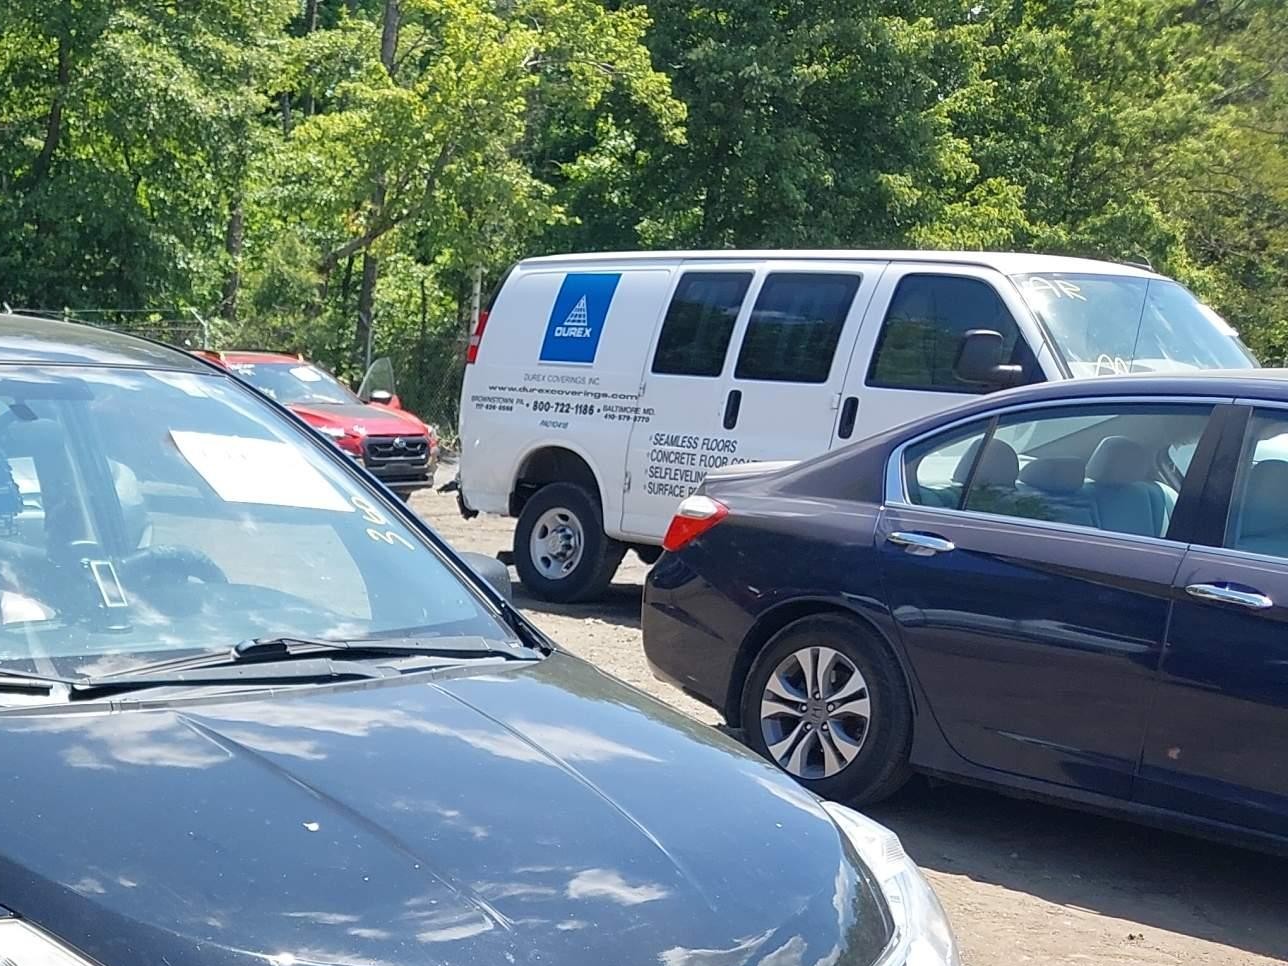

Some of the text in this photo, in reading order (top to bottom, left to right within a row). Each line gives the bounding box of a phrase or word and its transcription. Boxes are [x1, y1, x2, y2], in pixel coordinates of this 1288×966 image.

[554, 326, 592, 338] DUREX
[523, 373, 546, 382] DUREX
[547, 375, 586, 385] COVERINGS
[488, 384, 639, 400] www.durexcoverings.com
[532, 400, 594, 415] 800-722-1186
[602, 404, 641, 415] BALTIMORE
[653, 433, 738, 453] SEAMLESS FLOORS
[650, 449, 697, 466] CONCRETE
[698, 453, 728, 469] FLOOR
[647, 482, 685, 498] SURFACE
